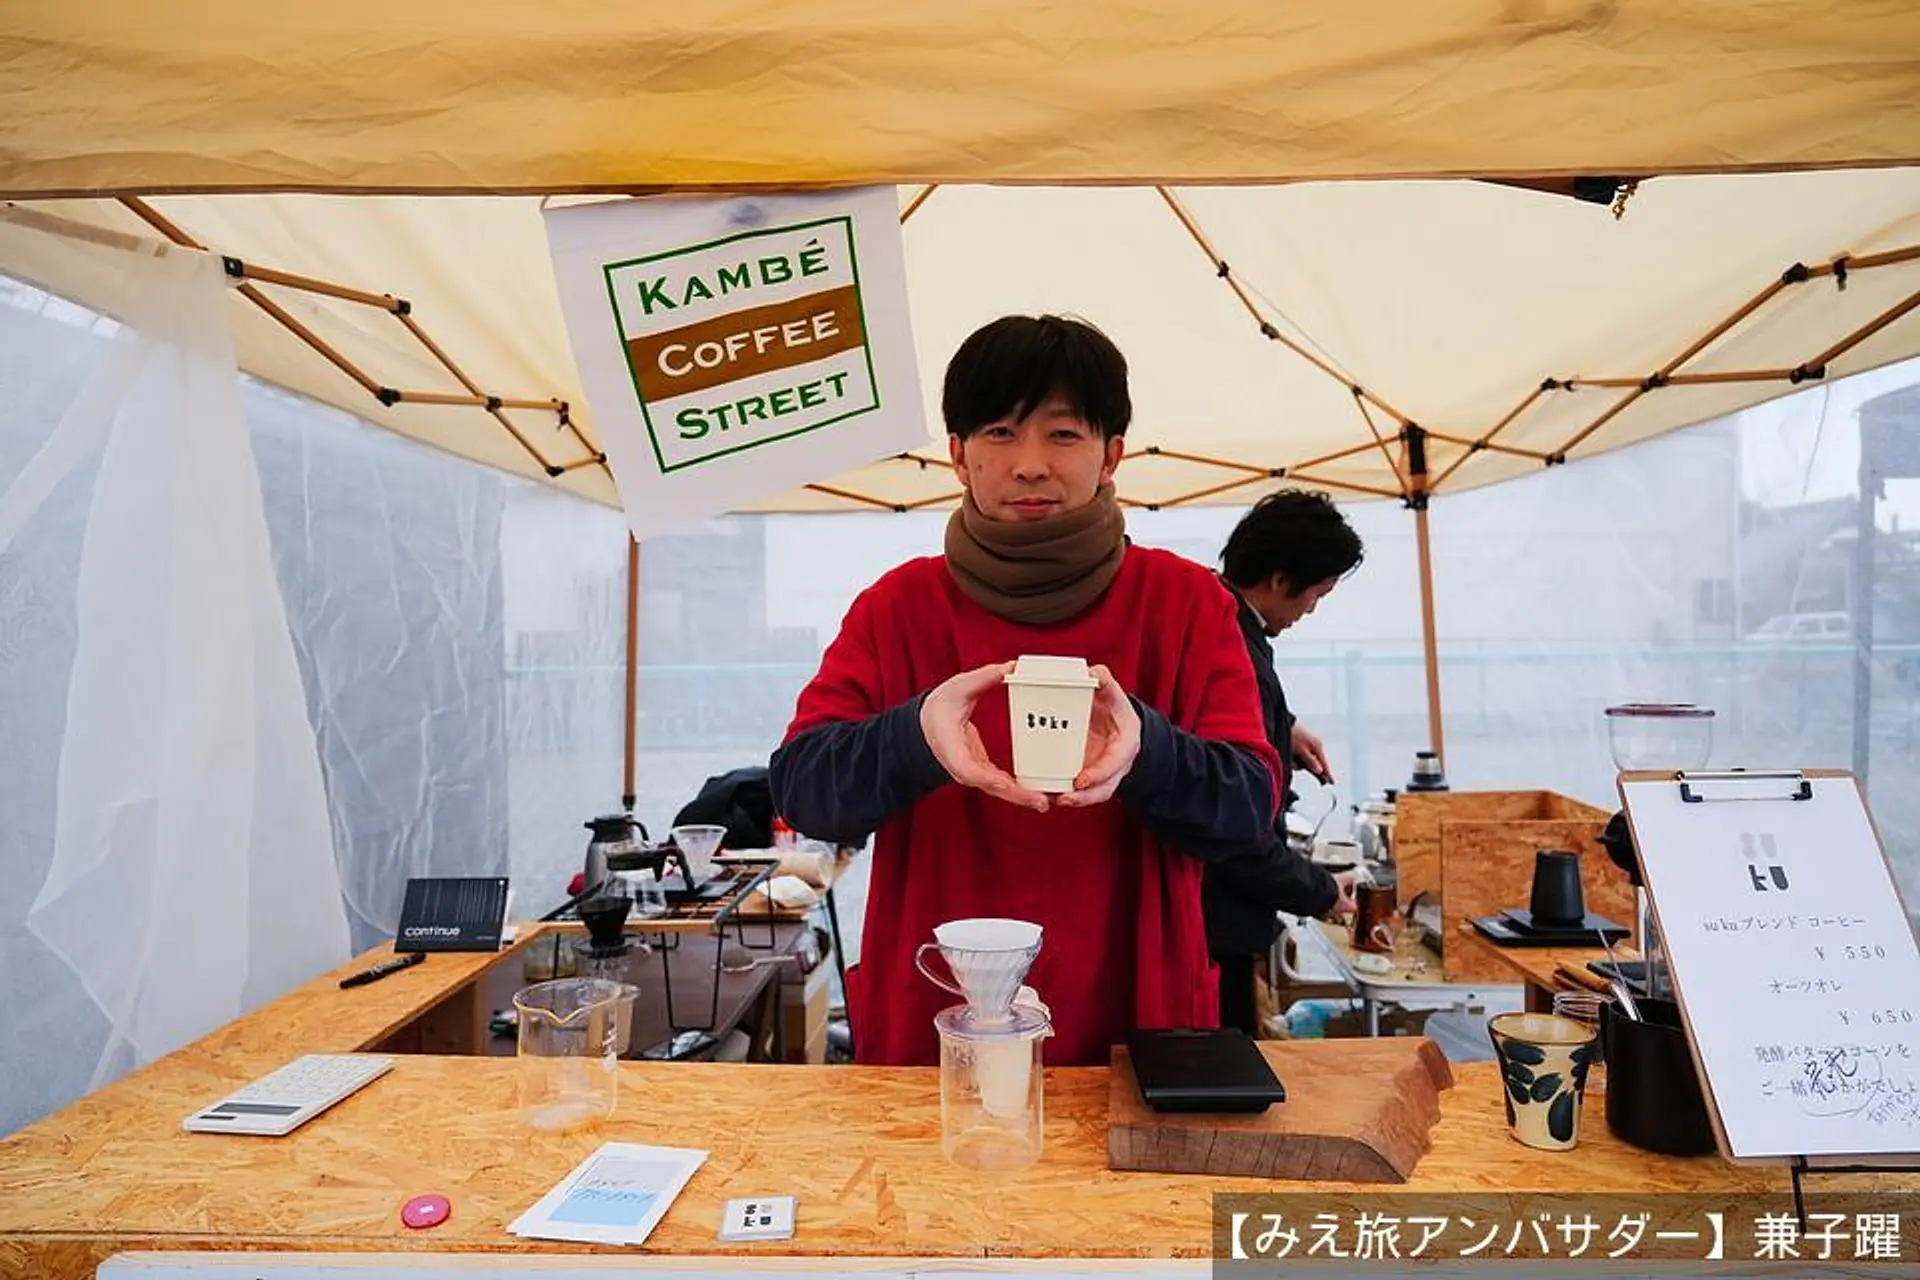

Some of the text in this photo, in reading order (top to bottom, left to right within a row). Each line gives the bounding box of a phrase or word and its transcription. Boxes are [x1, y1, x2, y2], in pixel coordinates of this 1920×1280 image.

[638, 238, 830, 315] KAMBÉ
[657, 310, 840, 377] COFFEE
[676, 371, 849, 440] STREET
[404, 926, 461, 937] continue
[1808, 916, 1866, 928] コーヒー
